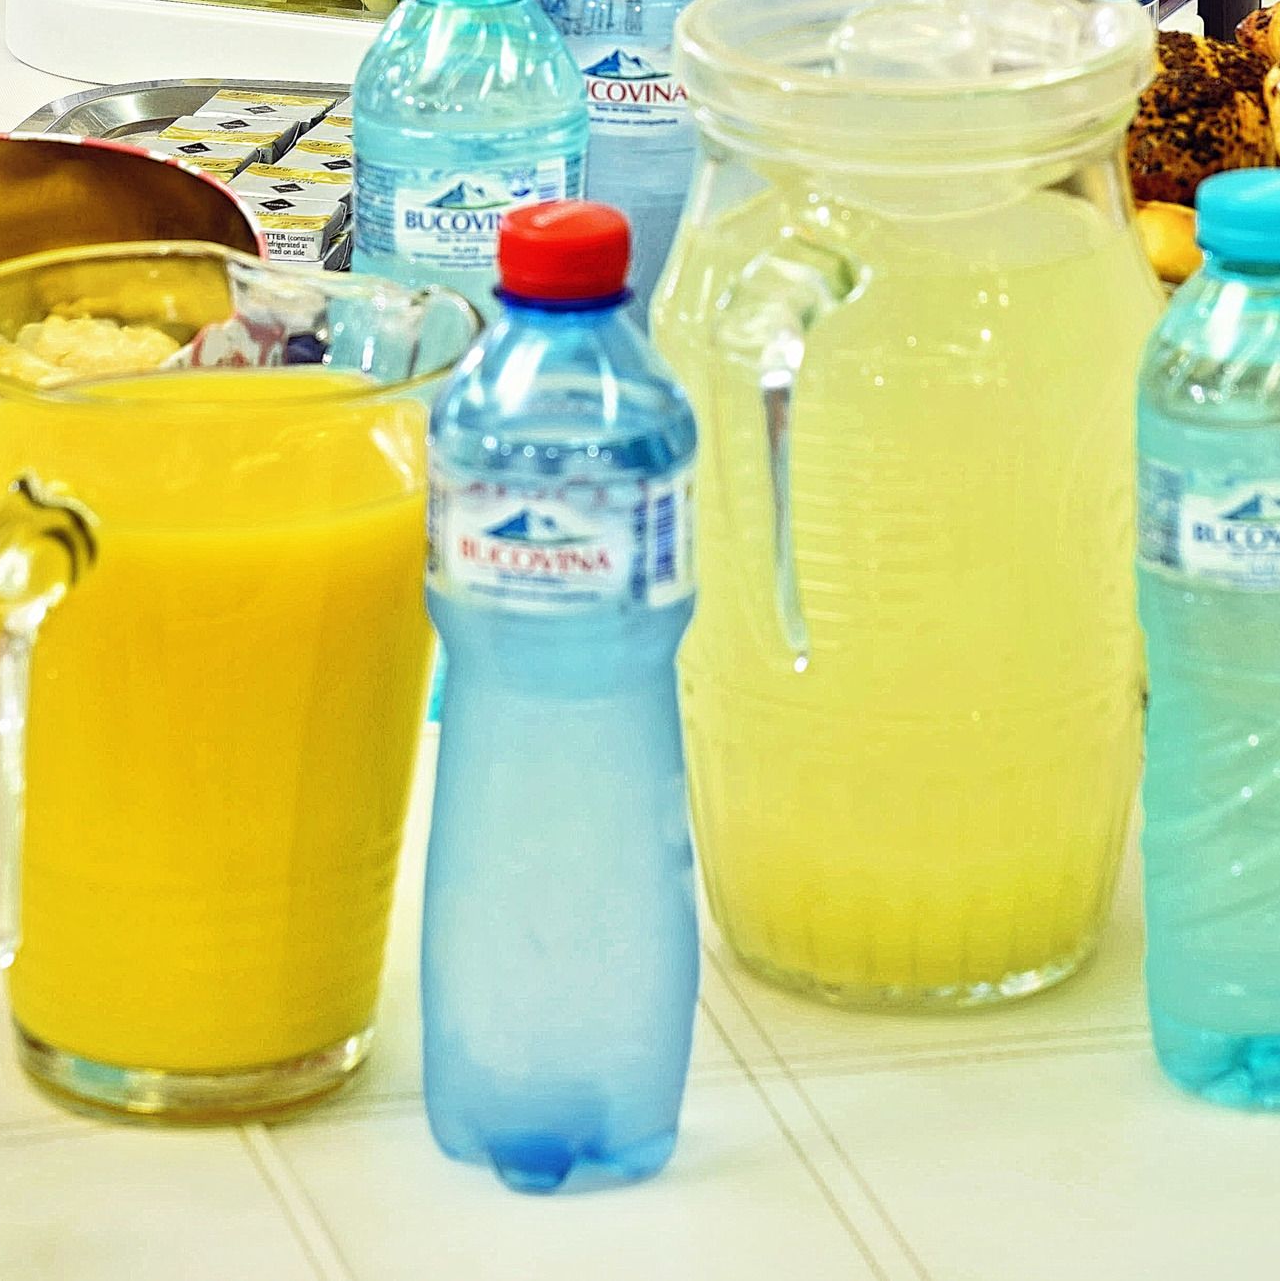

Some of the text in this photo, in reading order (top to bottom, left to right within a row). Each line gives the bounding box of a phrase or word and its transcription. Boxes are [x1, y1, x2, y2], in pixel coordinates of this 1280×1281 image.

[586, 80, 688, 103] COVINA
[405, 210, 502, 233] BUCOVI
[266, 233, 286, 241] TTER
[267, 240, 300, 249] efrigerated
[459, 536, 612, 573] BUCOVINA
